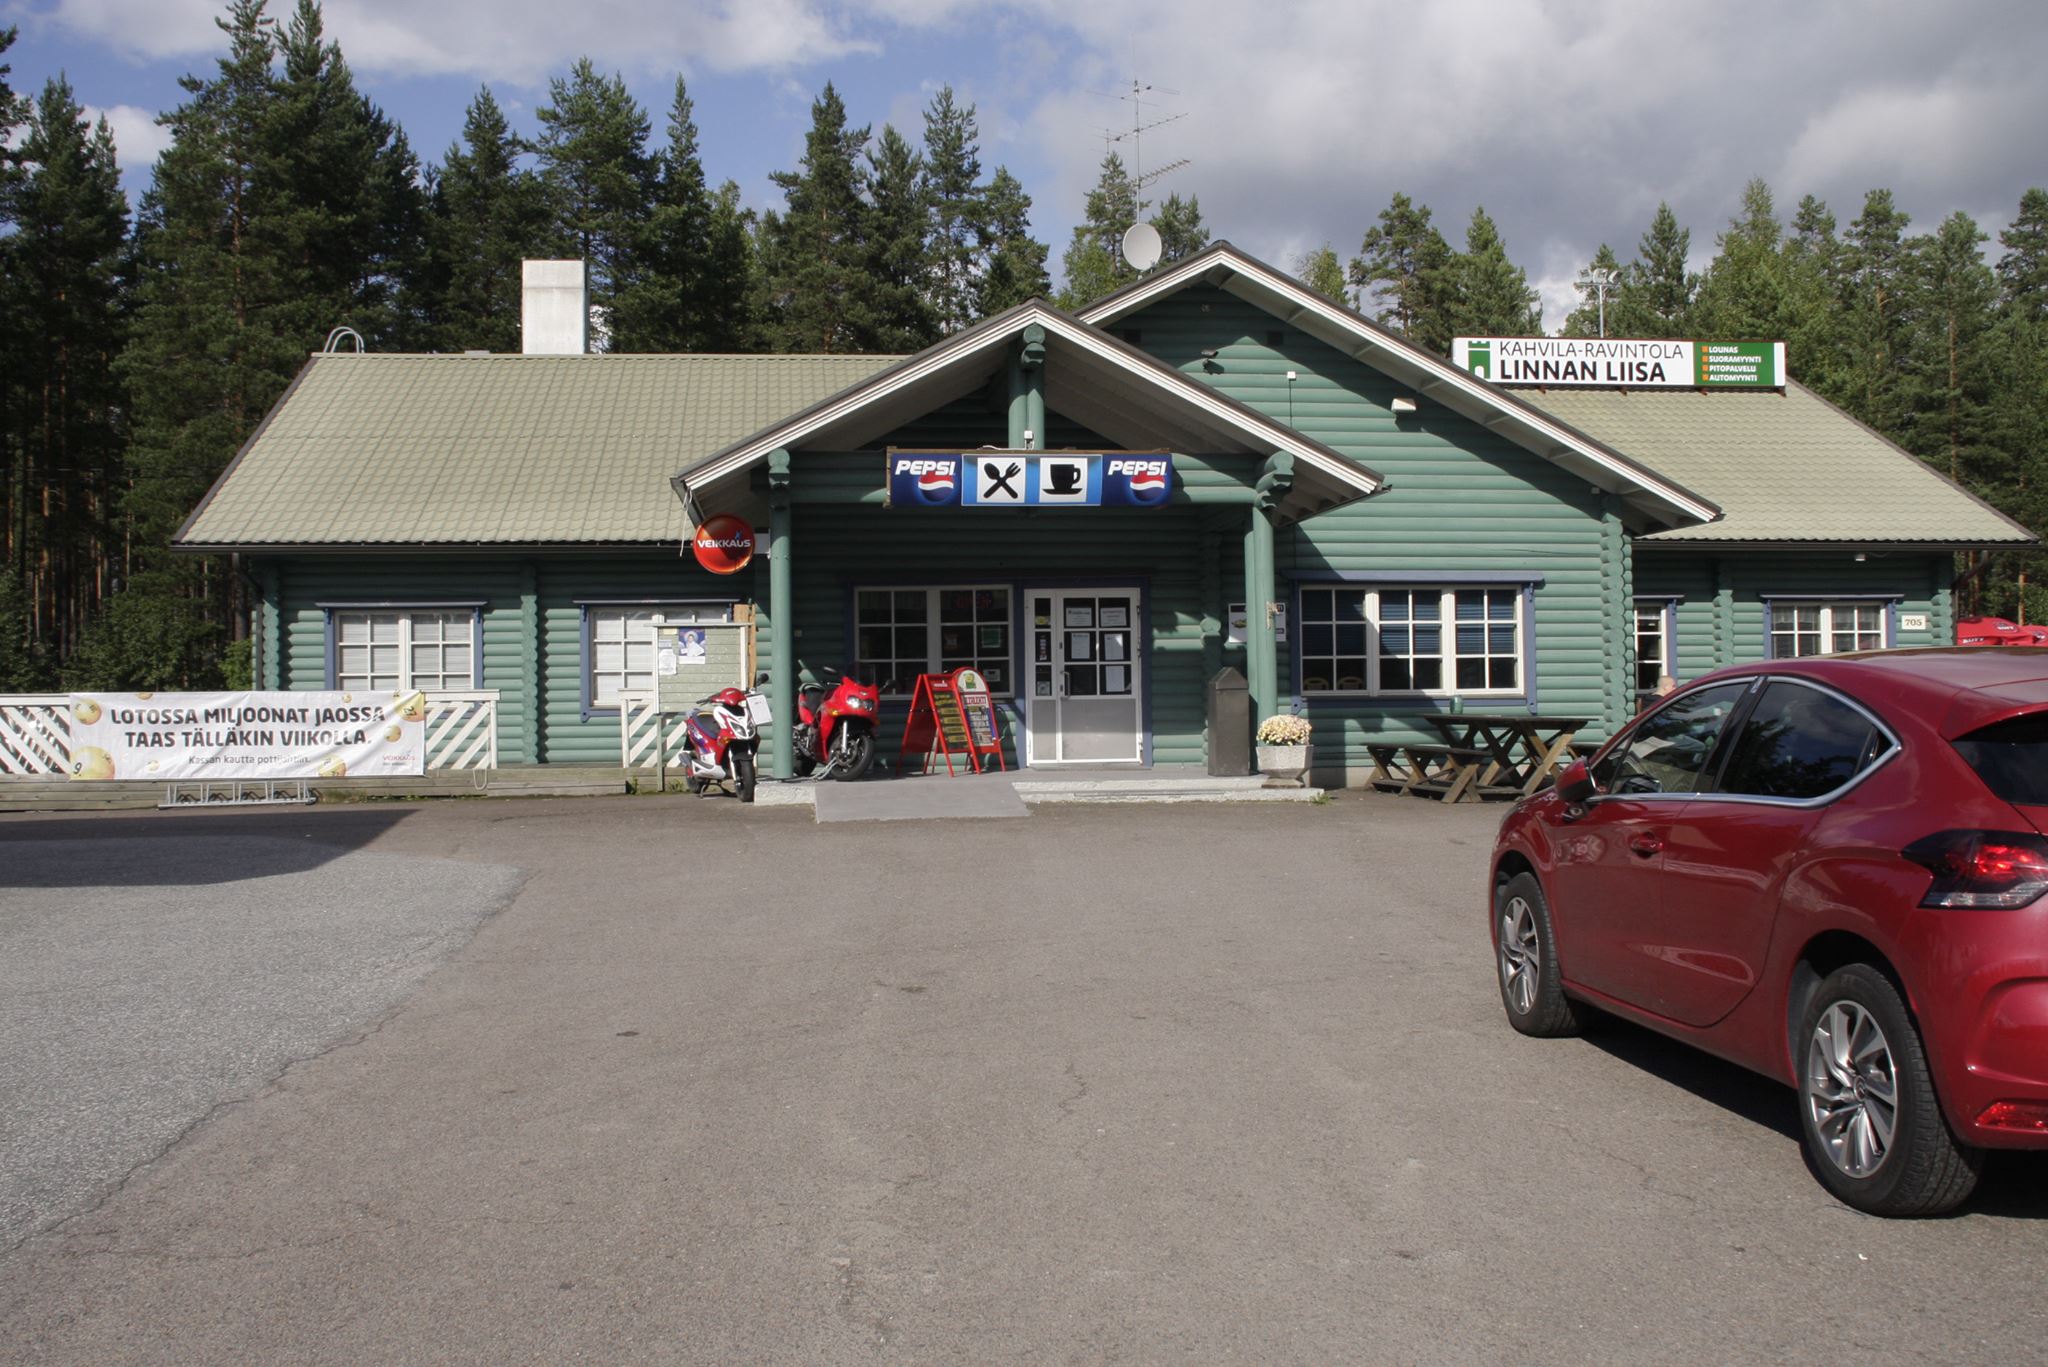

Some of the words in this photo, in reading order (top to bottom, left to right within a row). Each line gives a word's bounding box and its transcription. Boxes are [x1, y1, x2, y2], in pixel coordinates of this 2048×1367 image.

[1499, 341, 1684, 359] KAHVILA-RAVINTOLA
[1708, 346, 1739, 354] LOUNAS
[1500, 360, 1597, 381] LINNAN
[1606, 361, 1666, 382] LIISA
[1709, 365, 1757, 373] PITOPALVELU
[895, 460, 956, 475] PEPSI
[1107, 460, 1168, 475] PEPSI
[697, 539, 751, 549] VEIKKAUS
[1904, 619, 1922, 627] 705
[111, 709, 198, 724] LOTOSSA
[204, 707, 309, 726] MILJOONAT
[314, 706, 385, 727] JAOSSA
[125, 732, 175, 747] TAAS
[181, 727, 274, 747] TÄLLÄKIN
[280, 729, 372, 746] VIIKOLLA.
[189, 756, 221, 764] Kassan
[224, 755, 255, 764] kautta
